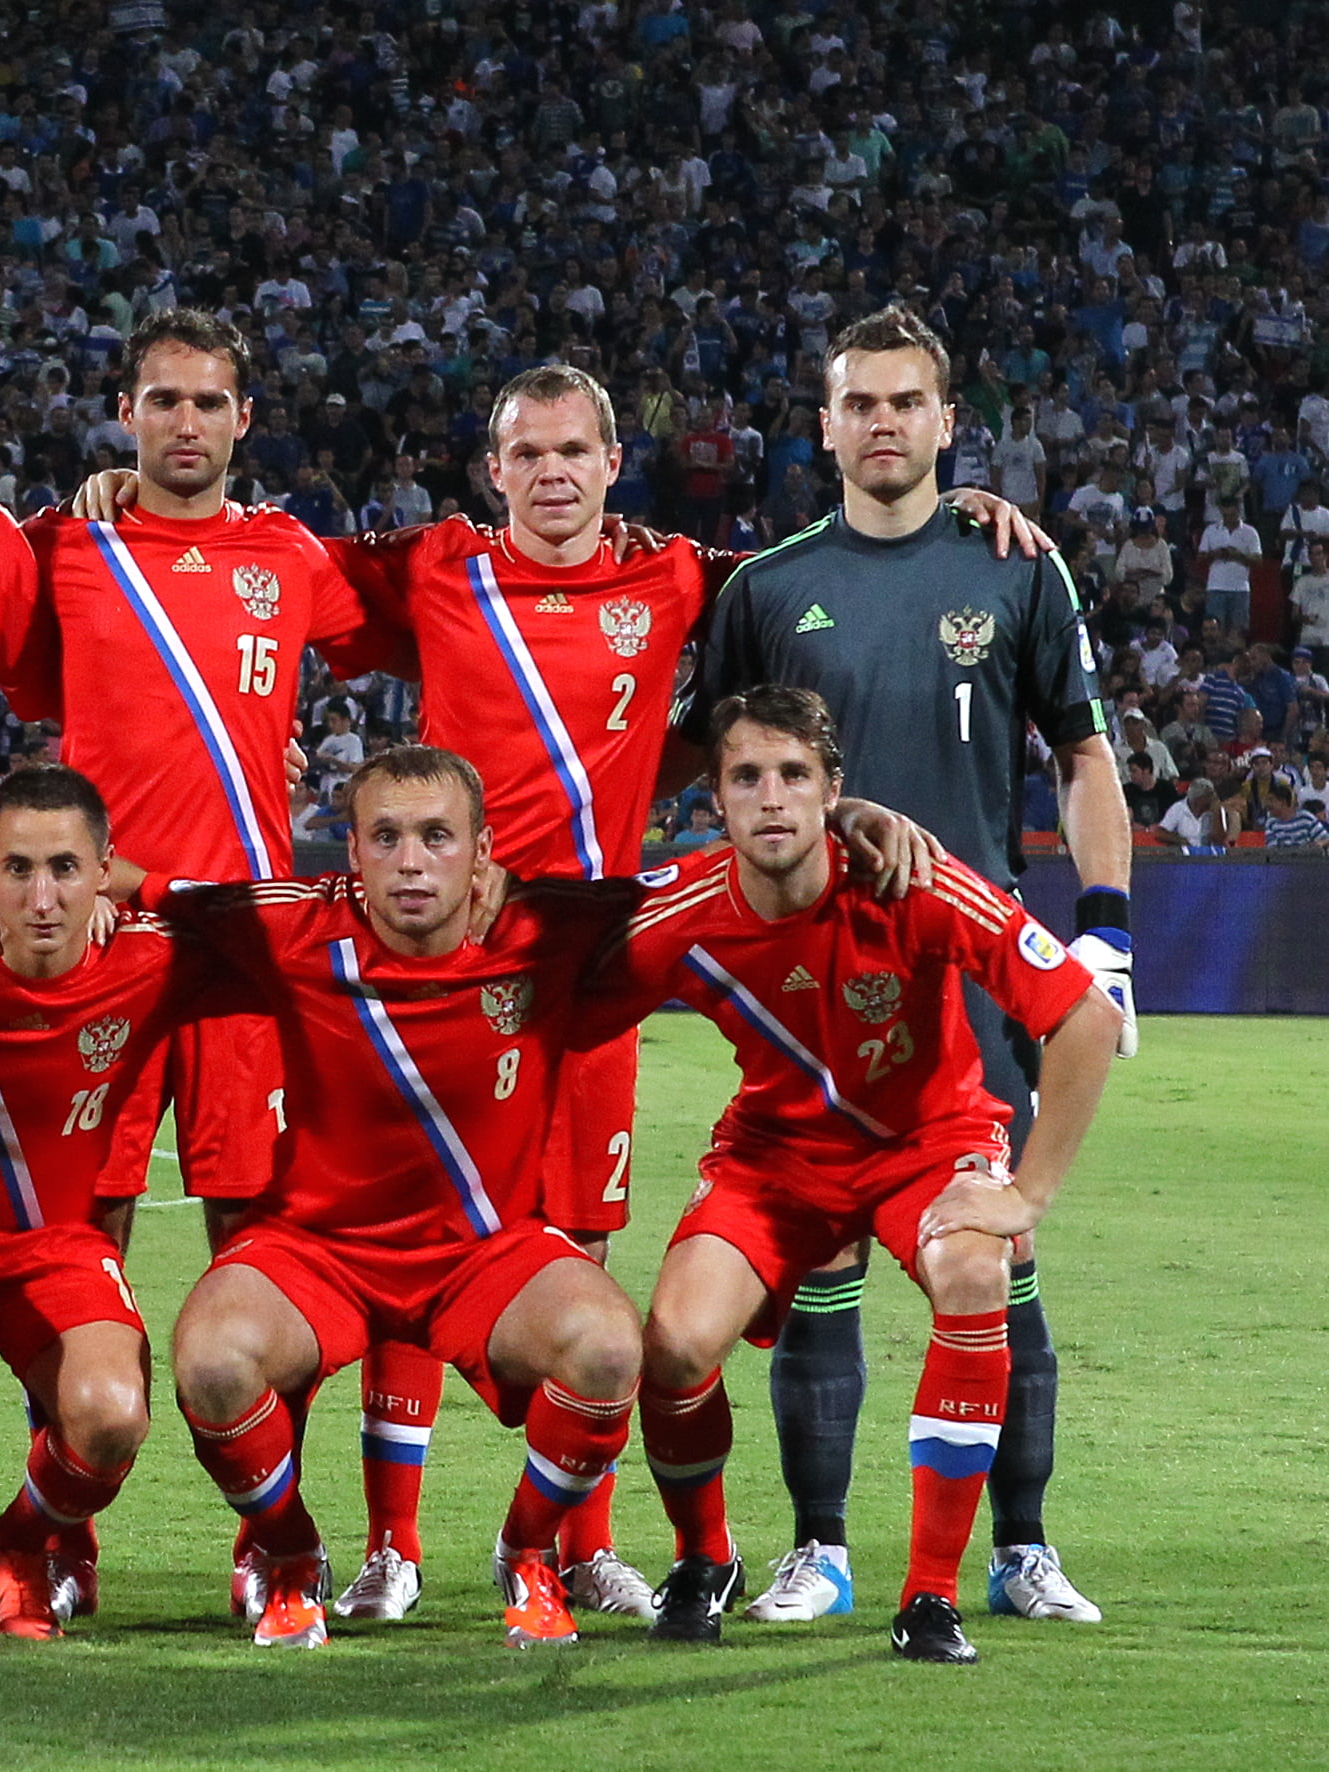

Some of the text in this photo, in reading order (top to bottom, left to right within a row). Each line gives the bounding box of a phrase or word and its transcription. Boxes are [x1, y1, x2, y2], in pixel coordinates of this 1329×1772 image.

[172, 563, 212, 573] adidas
[535, 603, 574, 614] adidas
[796, 618, 835, 634] adidas
[236, 633, 279, 697] 15
[606, 673, 636, 731] 2
[954, 682, 973, 742] 1
[781, 980, 820, 992] adidas
[494, 1048, 521, 1100] 8
[857, 1021, 914, 1083] 23
[61, 1082, 110, 1136] 18
[602, 1131, 630, 1202] 2
[369, 1390, 420, 1416] RFU
[938, 1398, 998, 1417] RFU
